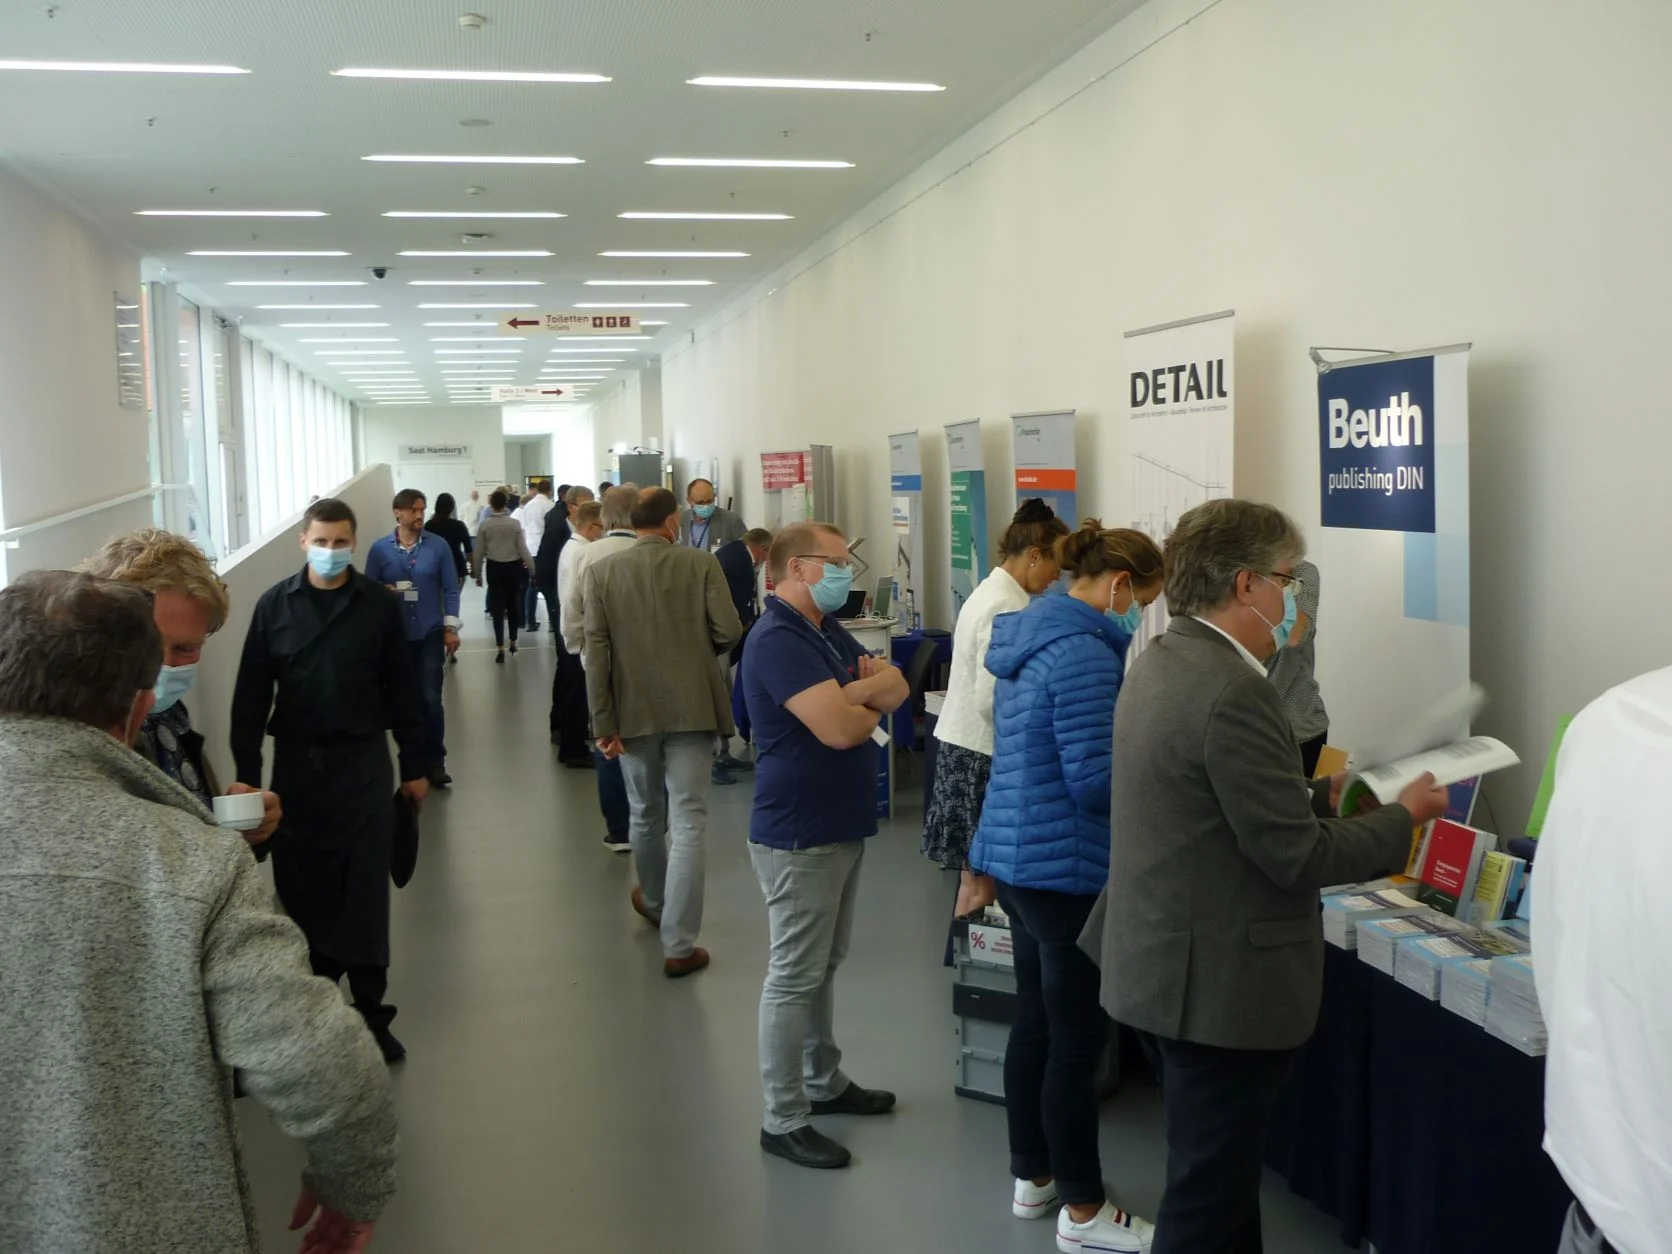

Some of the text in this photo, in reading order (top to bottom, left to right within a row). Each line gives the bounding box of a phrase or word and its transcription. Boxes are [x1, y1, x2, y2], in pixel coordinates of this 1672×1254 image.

[545, 314, 589, 324] Toiletten
[1130, 358, 1228, 408] DETAIL
[1328, 392, 1424, 449] Beuth
[407, 446, 426, 454] Saal
[427, 446, 462, 455] Hamburg
[1328, 466, 1424, 496] publishing DIN
[970, 931, 986, 949] %
